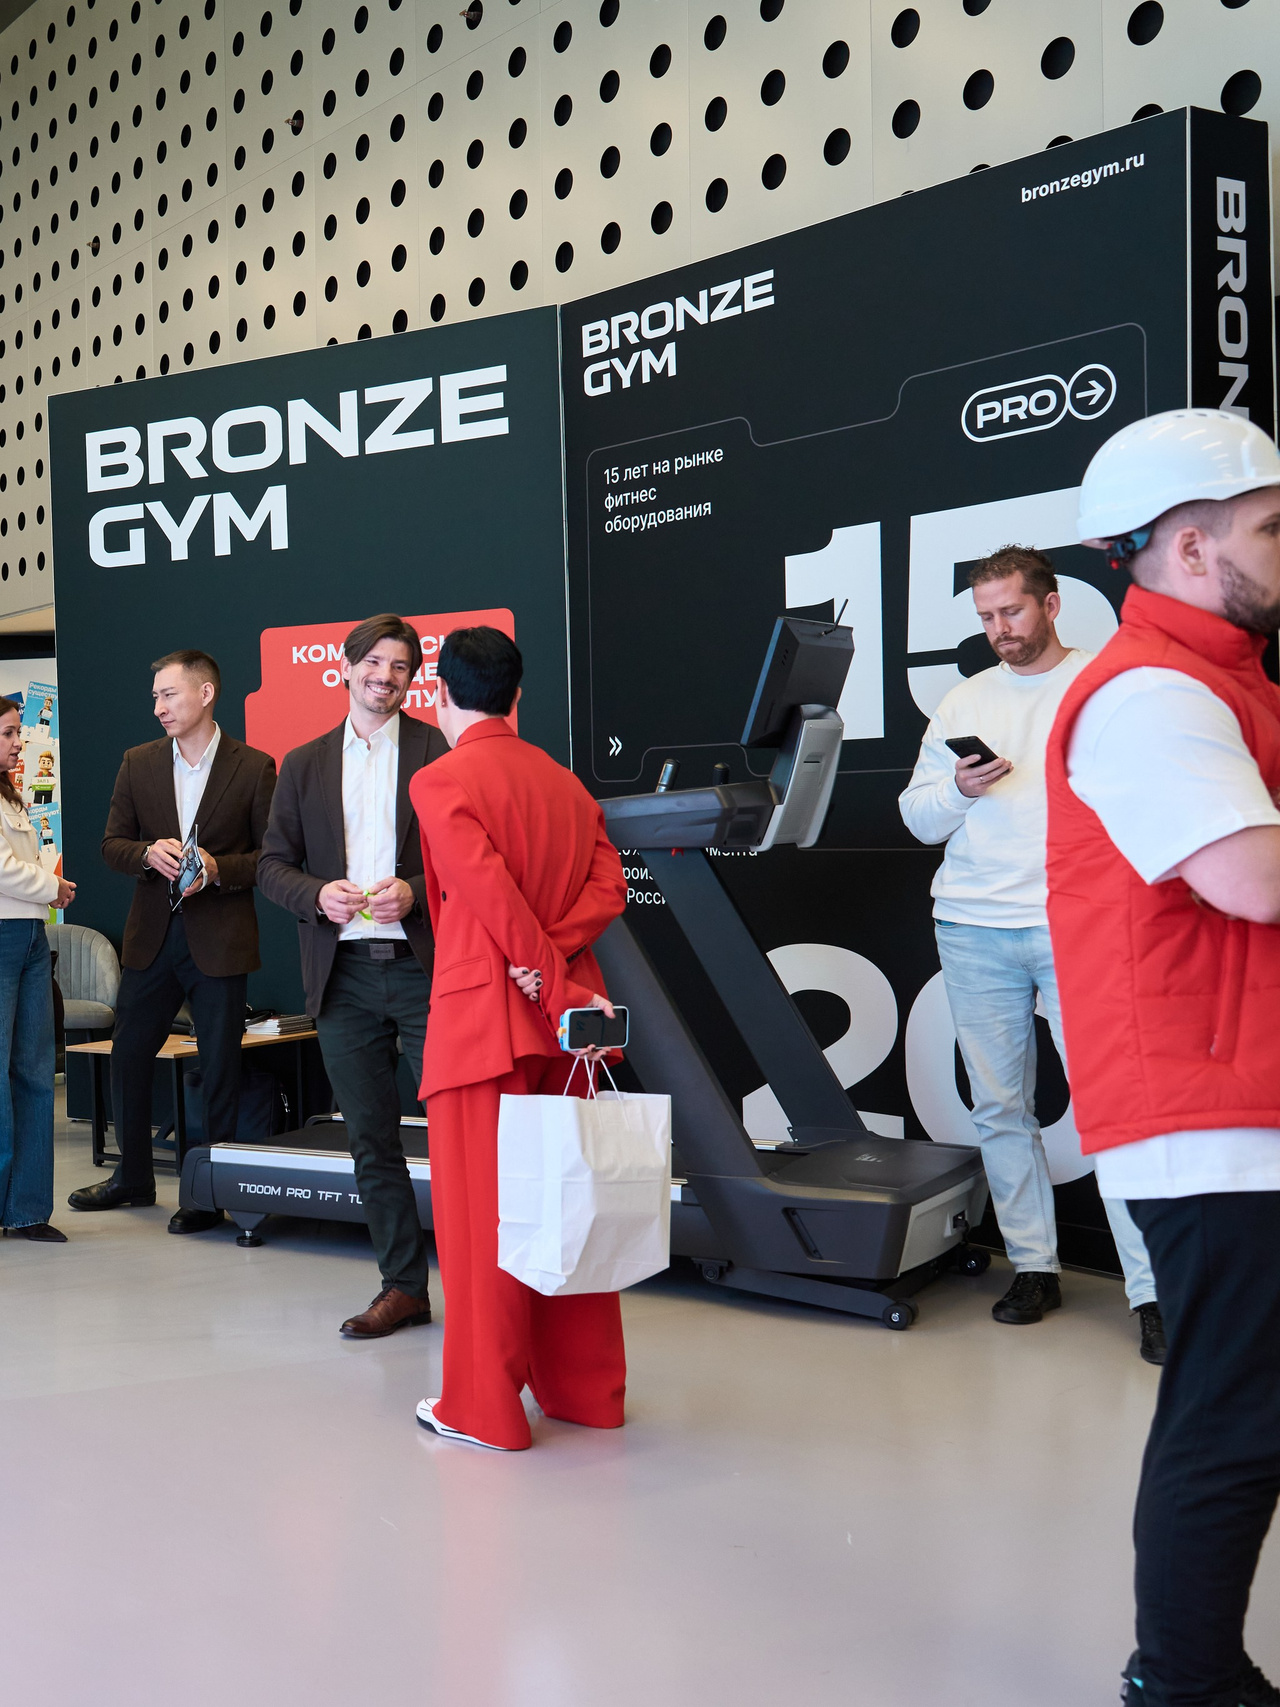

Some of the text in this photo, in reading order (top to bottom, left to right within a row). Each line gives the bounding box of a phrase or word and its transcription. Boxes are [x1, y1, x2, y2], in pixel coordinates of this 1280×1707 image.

[1021, 153, 1146, 203] bronzegym.ru
[581, 268, 776, 358] BRONZE
[583, 341, 677, 397] GYM
[85, 364, 510, 493] BRONZE
[976, 389, 1057, 429] PRO
[603, 448, 724, 485] 15 лет на рынке
[604, 487, 657, 513] фитнес
[604, 501, 712, 534] оборудования
[88, 484, 289, 568] GYM
[238, 1182, 282, 1196] T1000M
[286, 1187, 312, 1199] PRO
[317, 1190, 343, 1202] TFT
